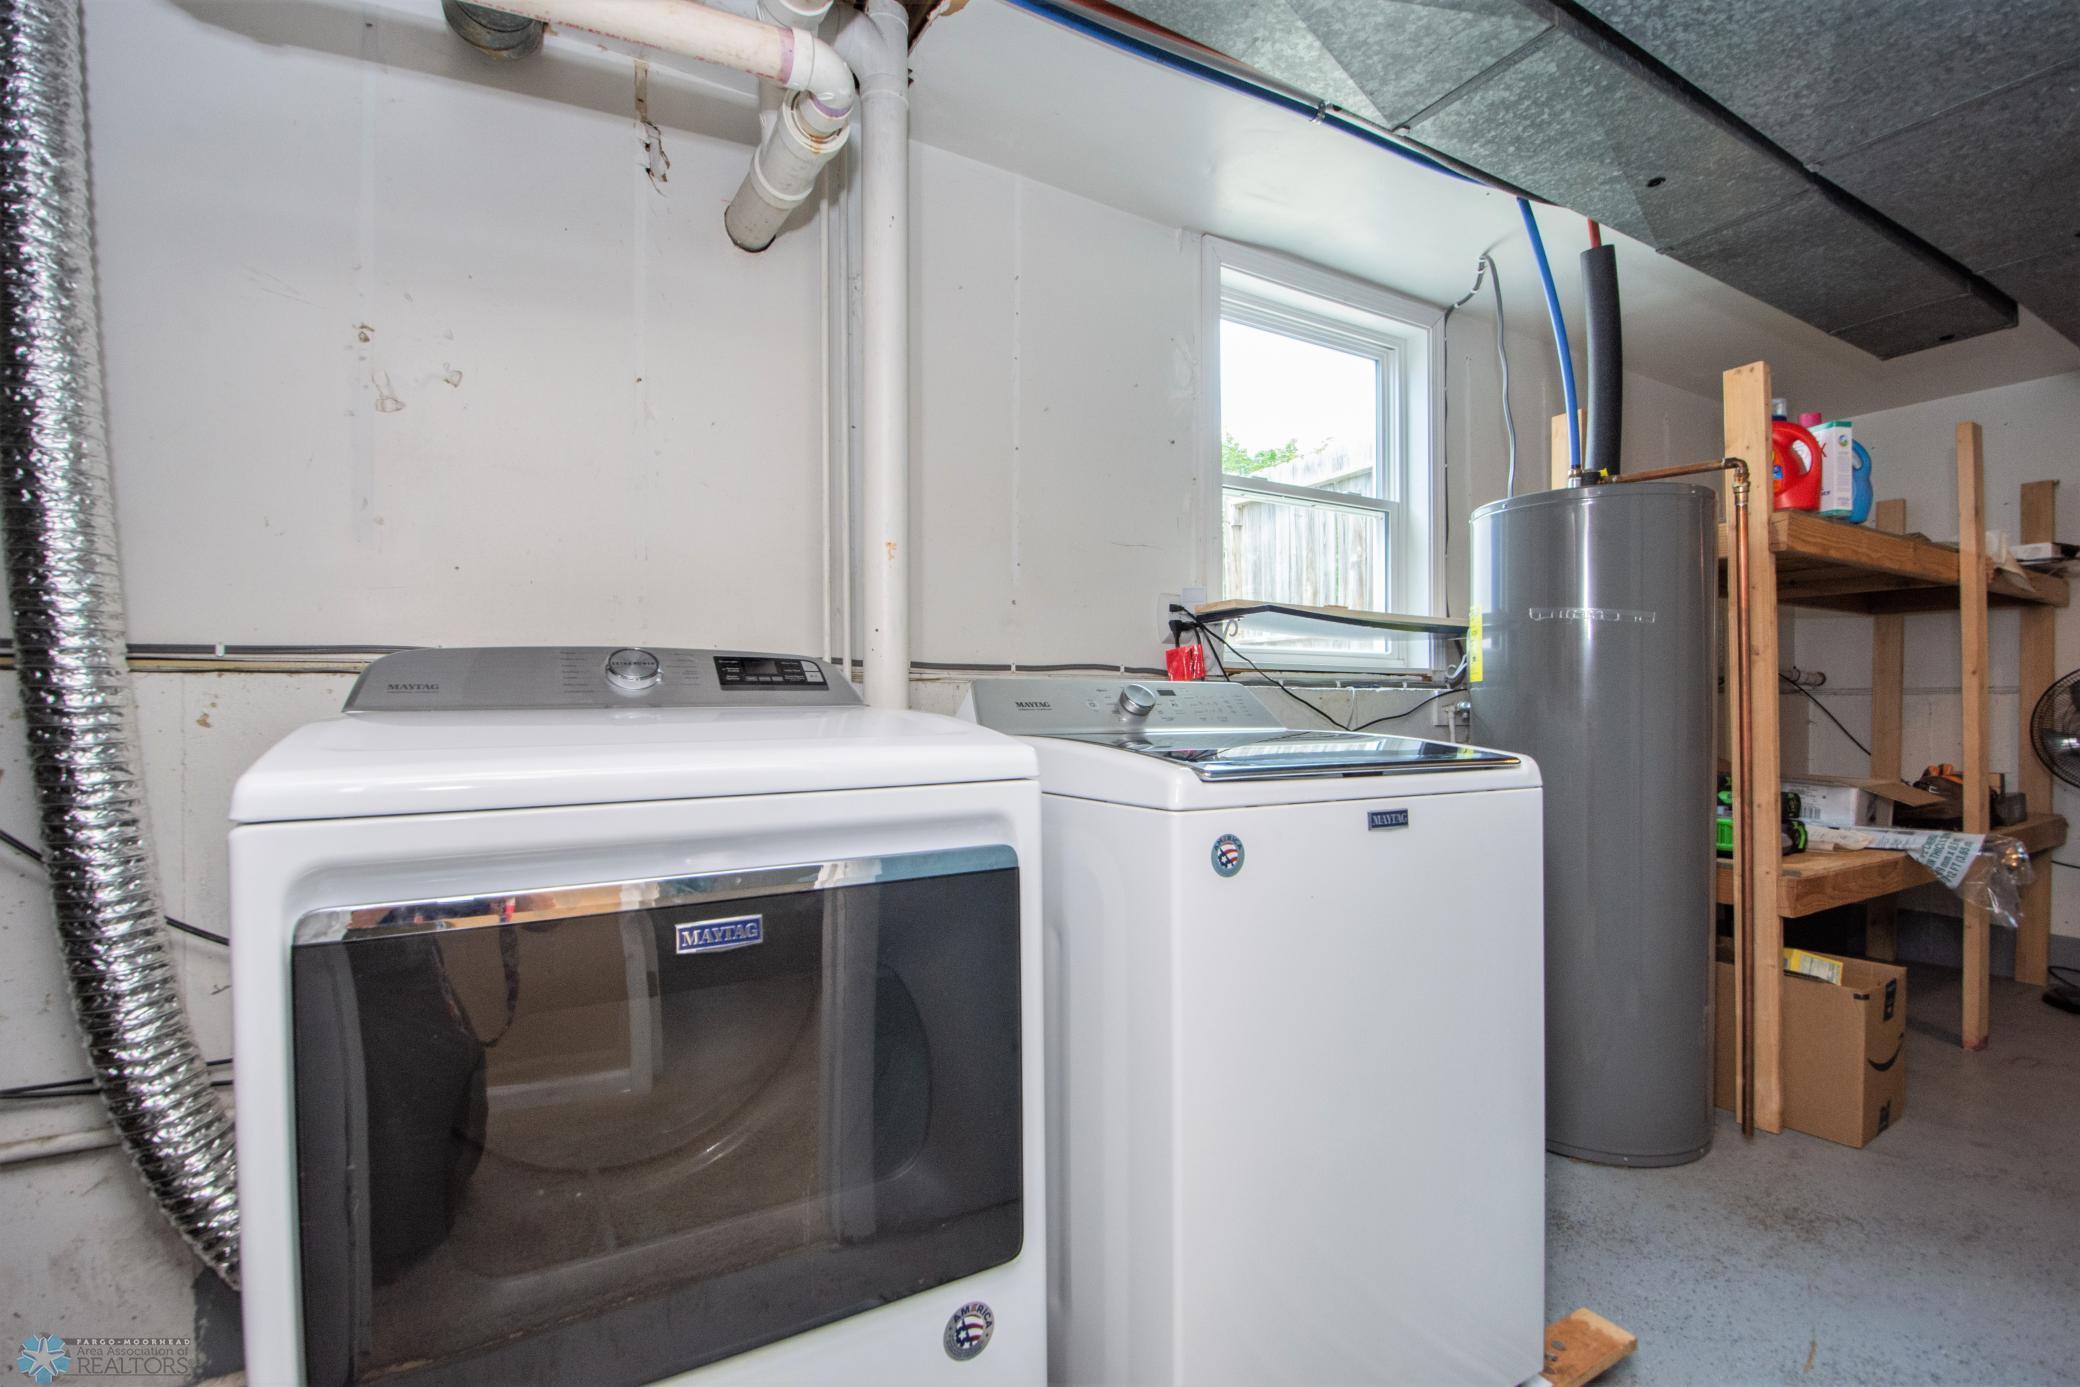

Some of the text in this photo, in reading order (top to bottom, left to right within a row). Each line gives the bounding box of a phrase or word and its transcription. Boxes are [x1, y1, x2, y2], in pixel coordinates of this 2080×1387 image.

[1371, 812, 1408, 826] MAYTAG
[681, 922, 758, 948] MAYTAG
[953, 1303, 993, 1329] AMERICA
